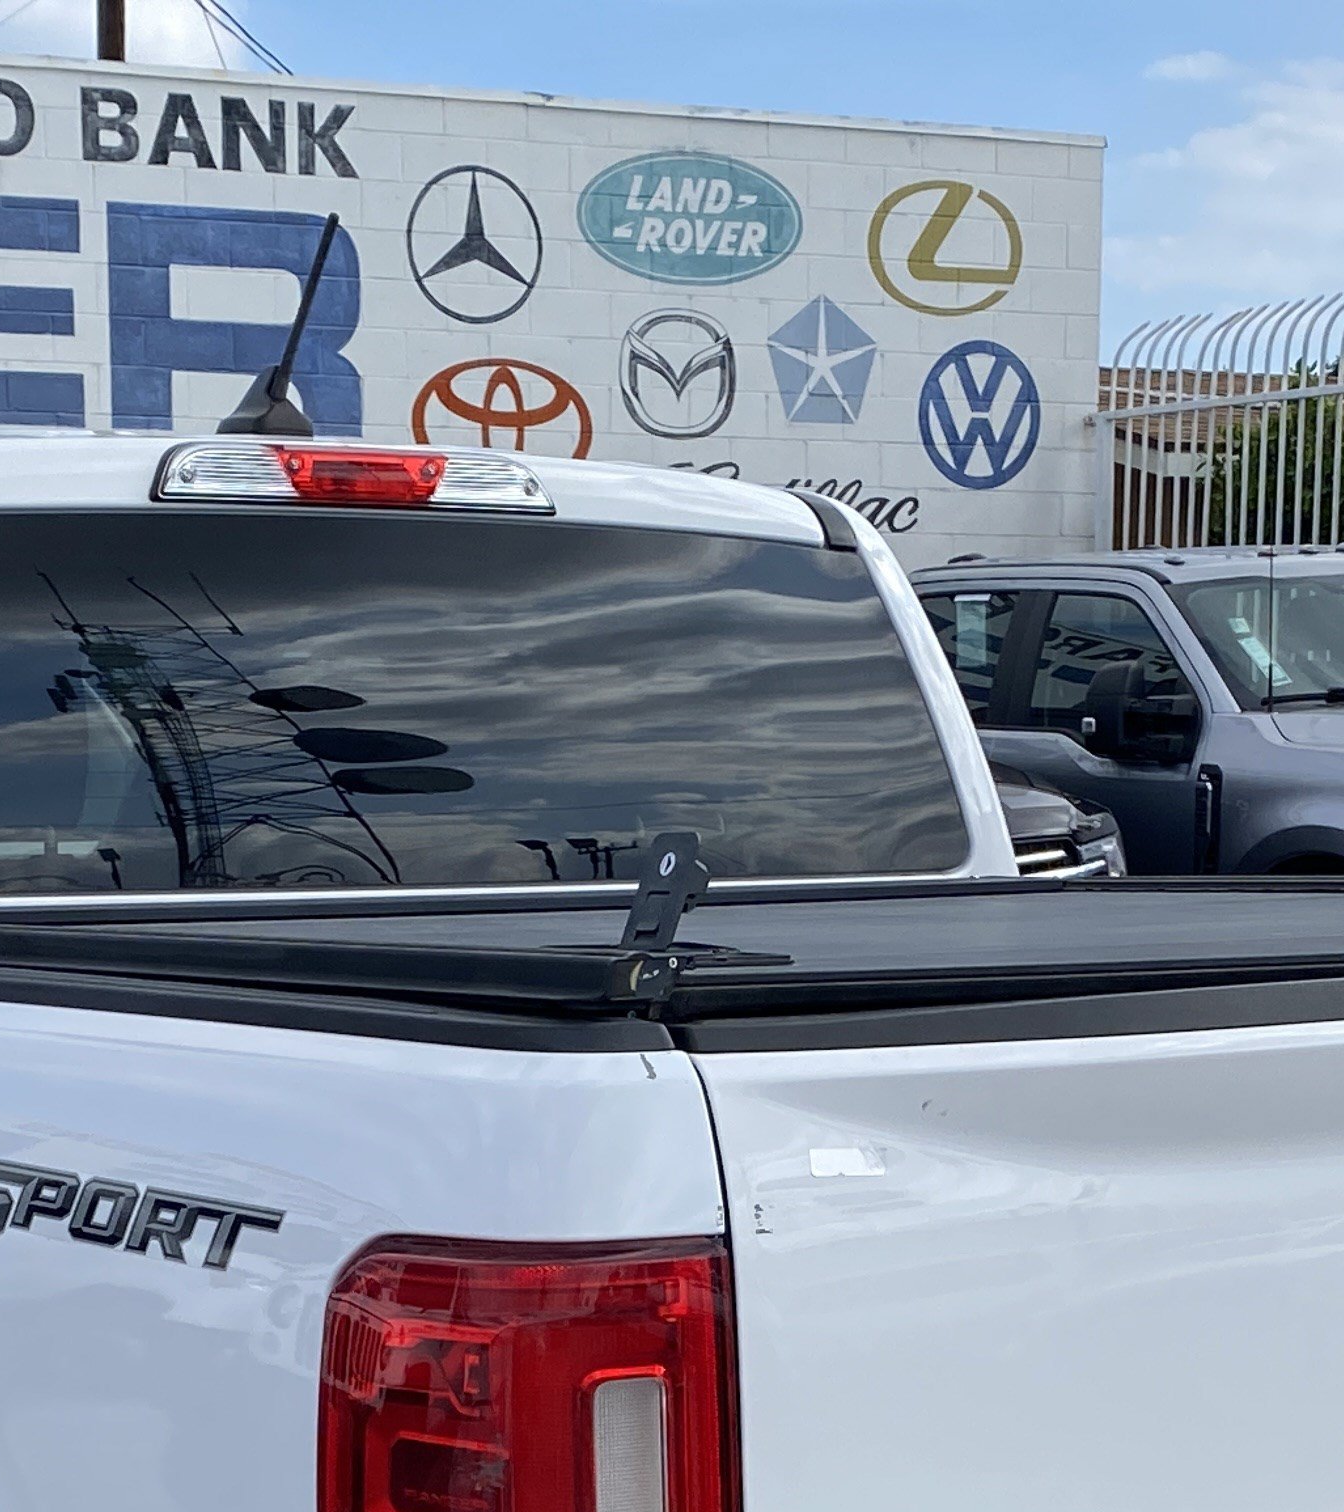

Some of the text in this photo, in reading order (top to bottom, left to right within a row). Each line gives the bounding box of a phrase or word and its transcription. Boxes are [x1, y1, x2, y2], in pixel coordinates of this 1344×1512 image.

[80, 86, 360, 179] BANK
[625, 174, 733, 215] LAND
[636, 216, 768, 258] ROVER
